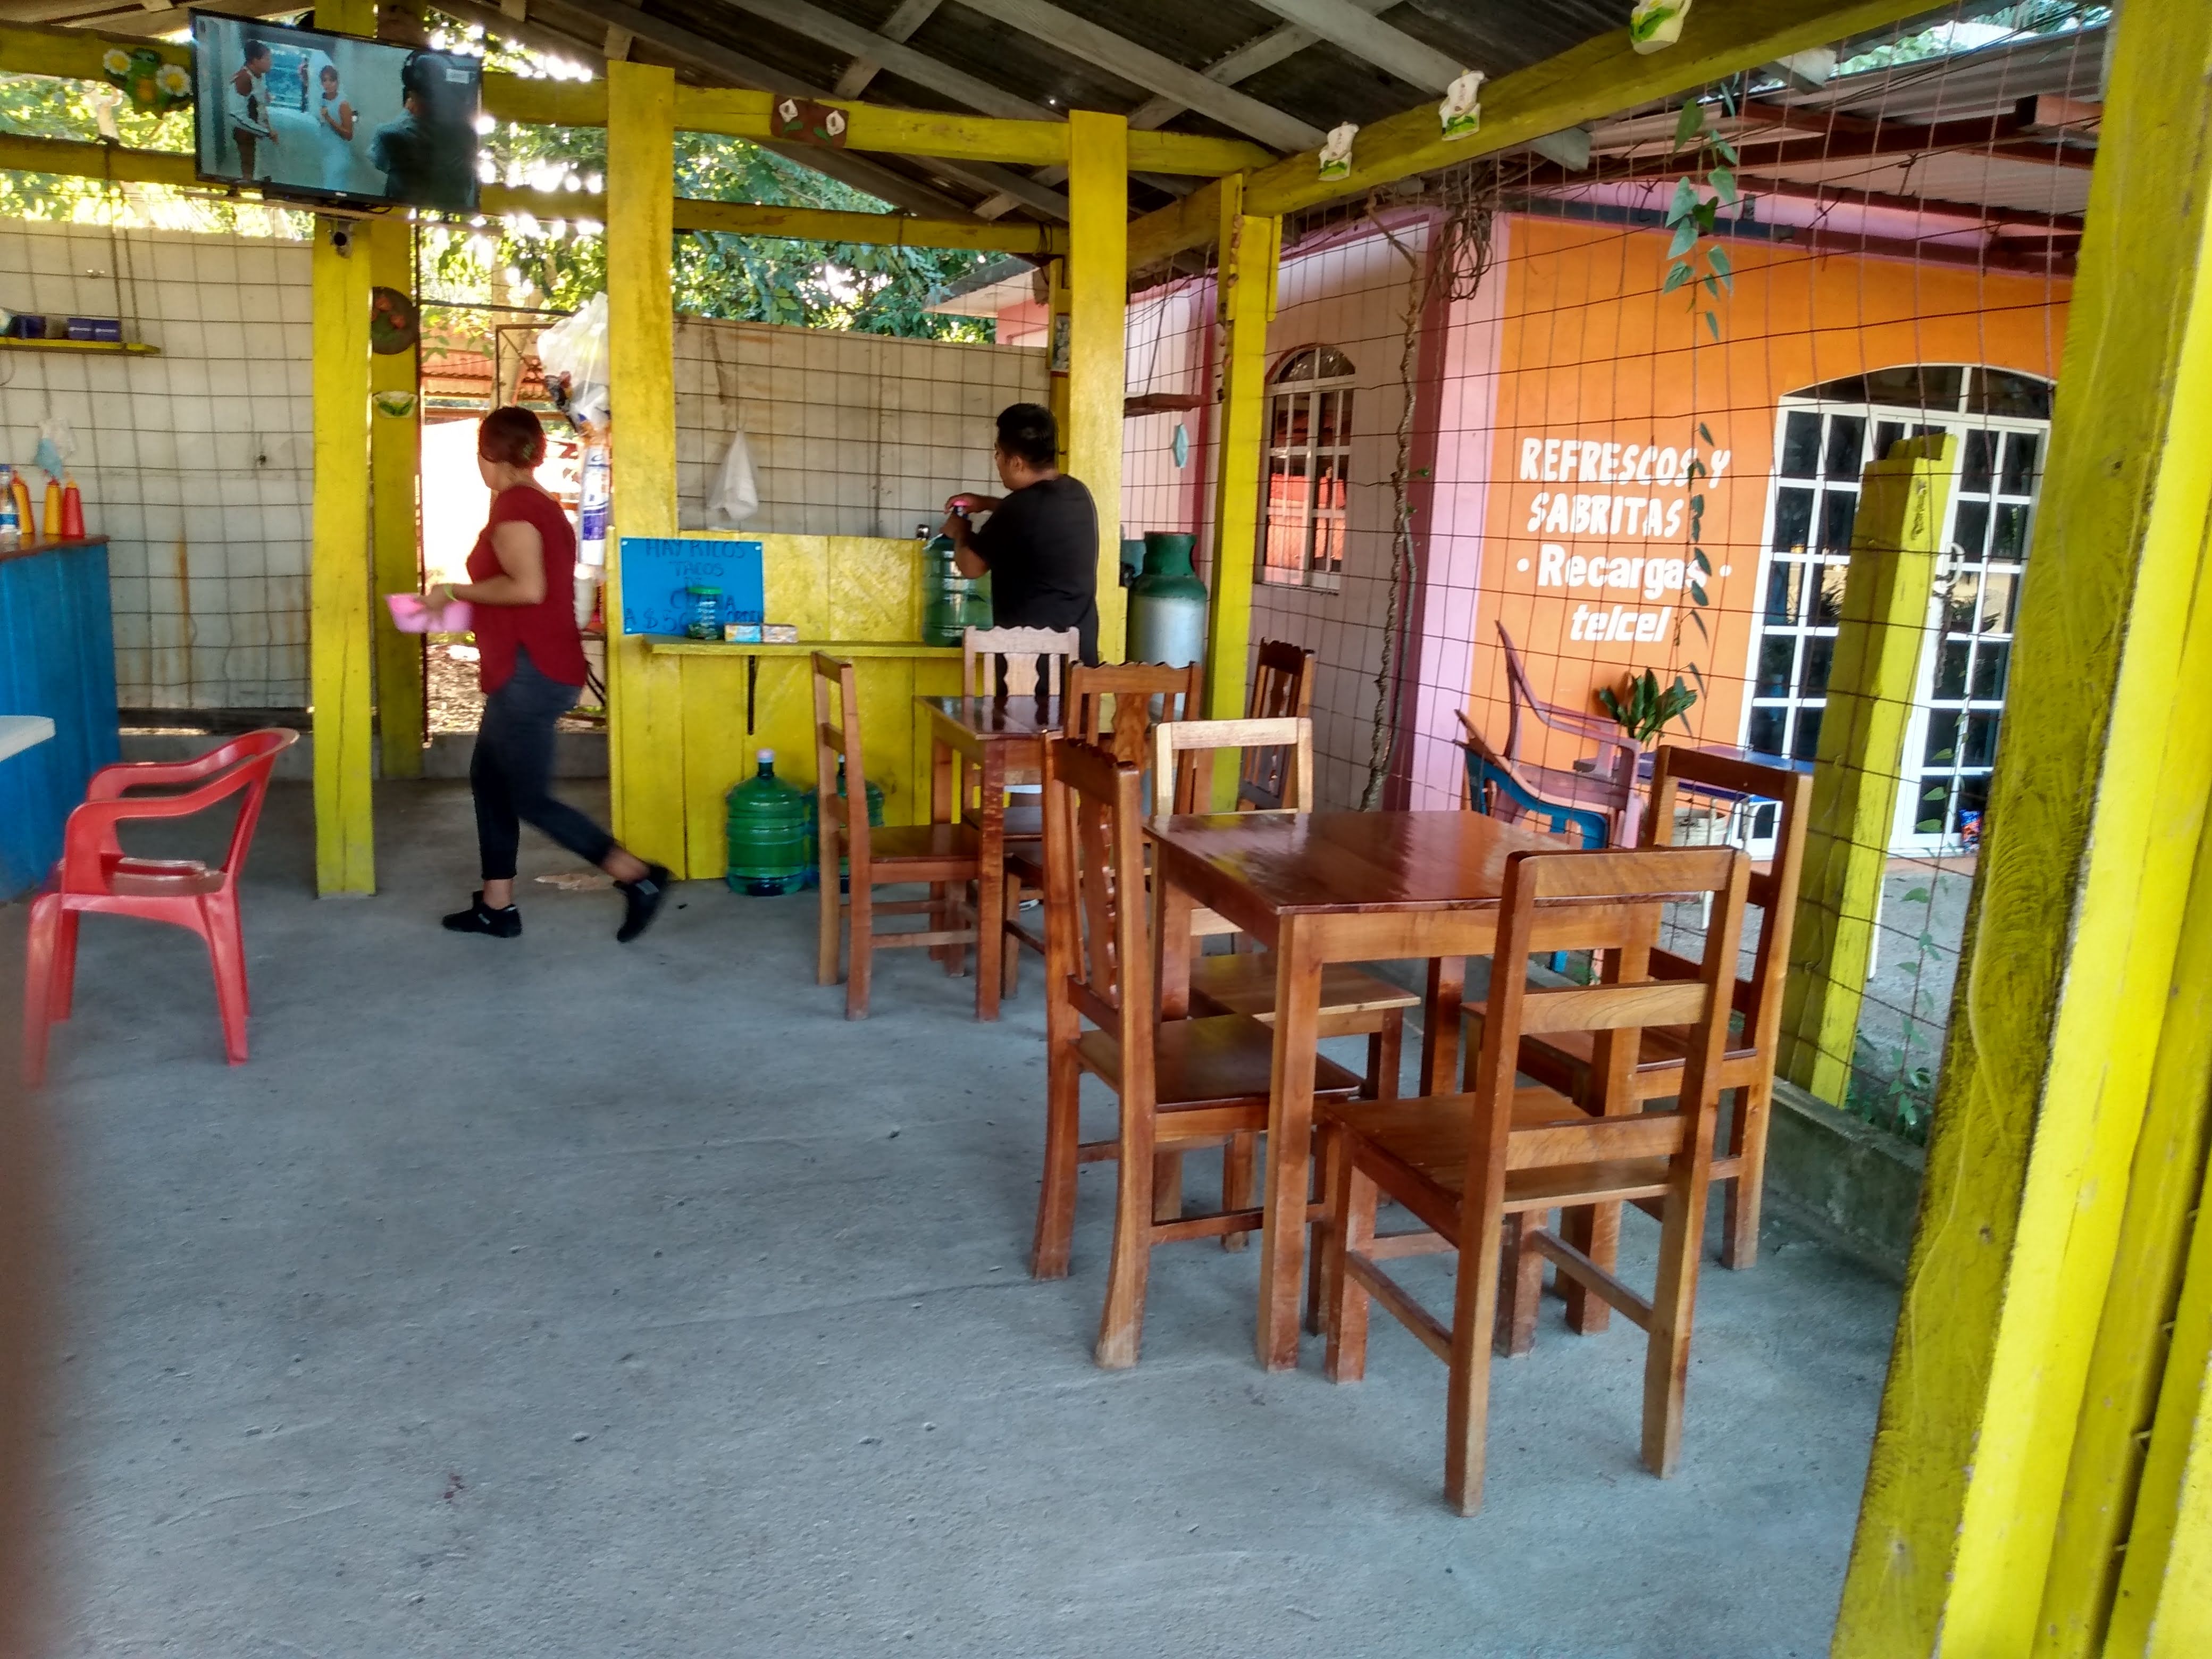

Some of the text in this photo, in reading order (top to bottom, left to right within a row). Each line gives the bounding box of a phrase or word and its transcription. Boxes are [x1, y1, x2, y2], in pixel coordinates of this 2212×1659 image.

[1520, 438, 1731, 489] REFRESCOS Y
[1527, 492, 1685, 538] SABRITAS
[645, 539, 747, 559] HAY RICOS
[669, 560, 724, 577] TACOS
[1537, 543, 1708, 600] Recargas
[1569, 604, 1673, 642] telcel
